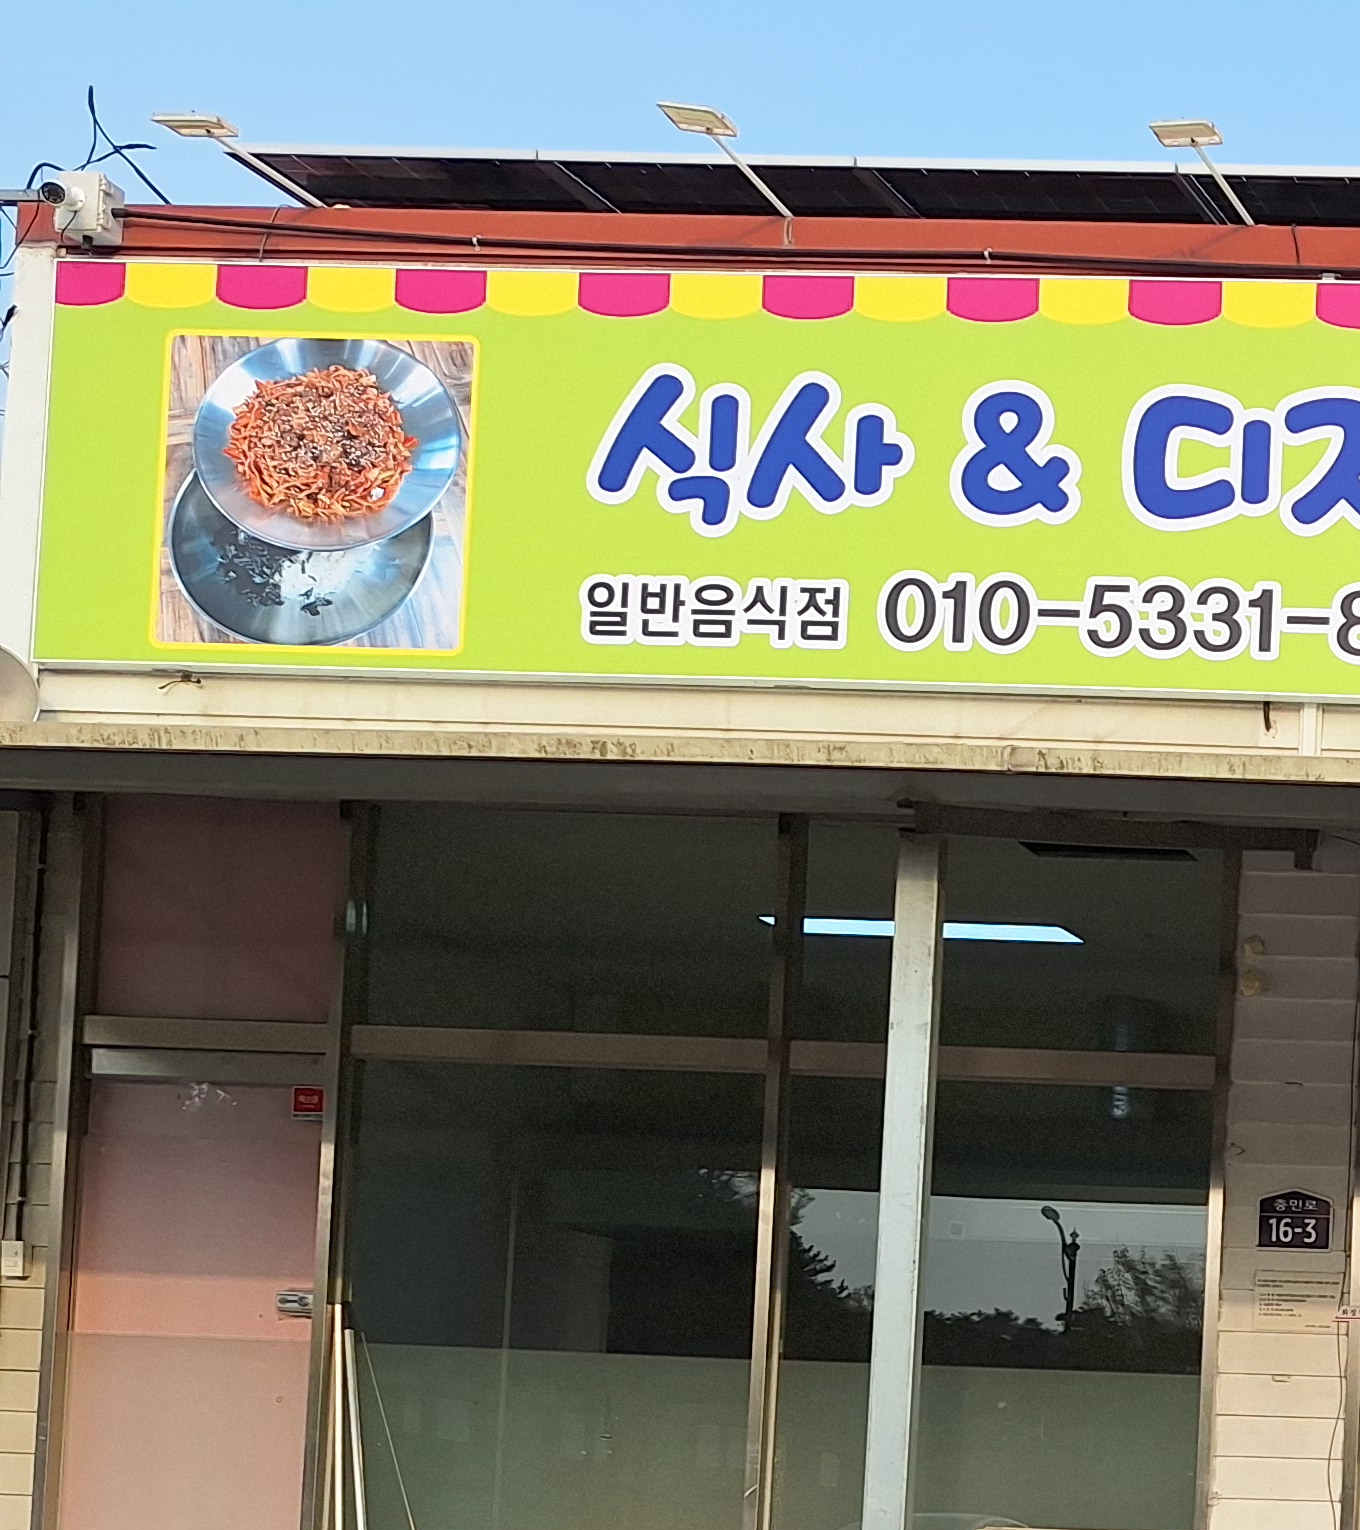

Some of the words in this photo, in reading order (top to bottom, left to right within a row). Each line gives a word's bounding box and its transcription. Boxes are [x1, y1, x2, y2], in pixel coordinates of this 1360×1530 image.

[596, 372, 906, 528] 식사
[959, 390, 1073, 518] &
[584, 579, 841, 643] 일반음식점
[1268, 1217, 1318, 1243] 16-3
